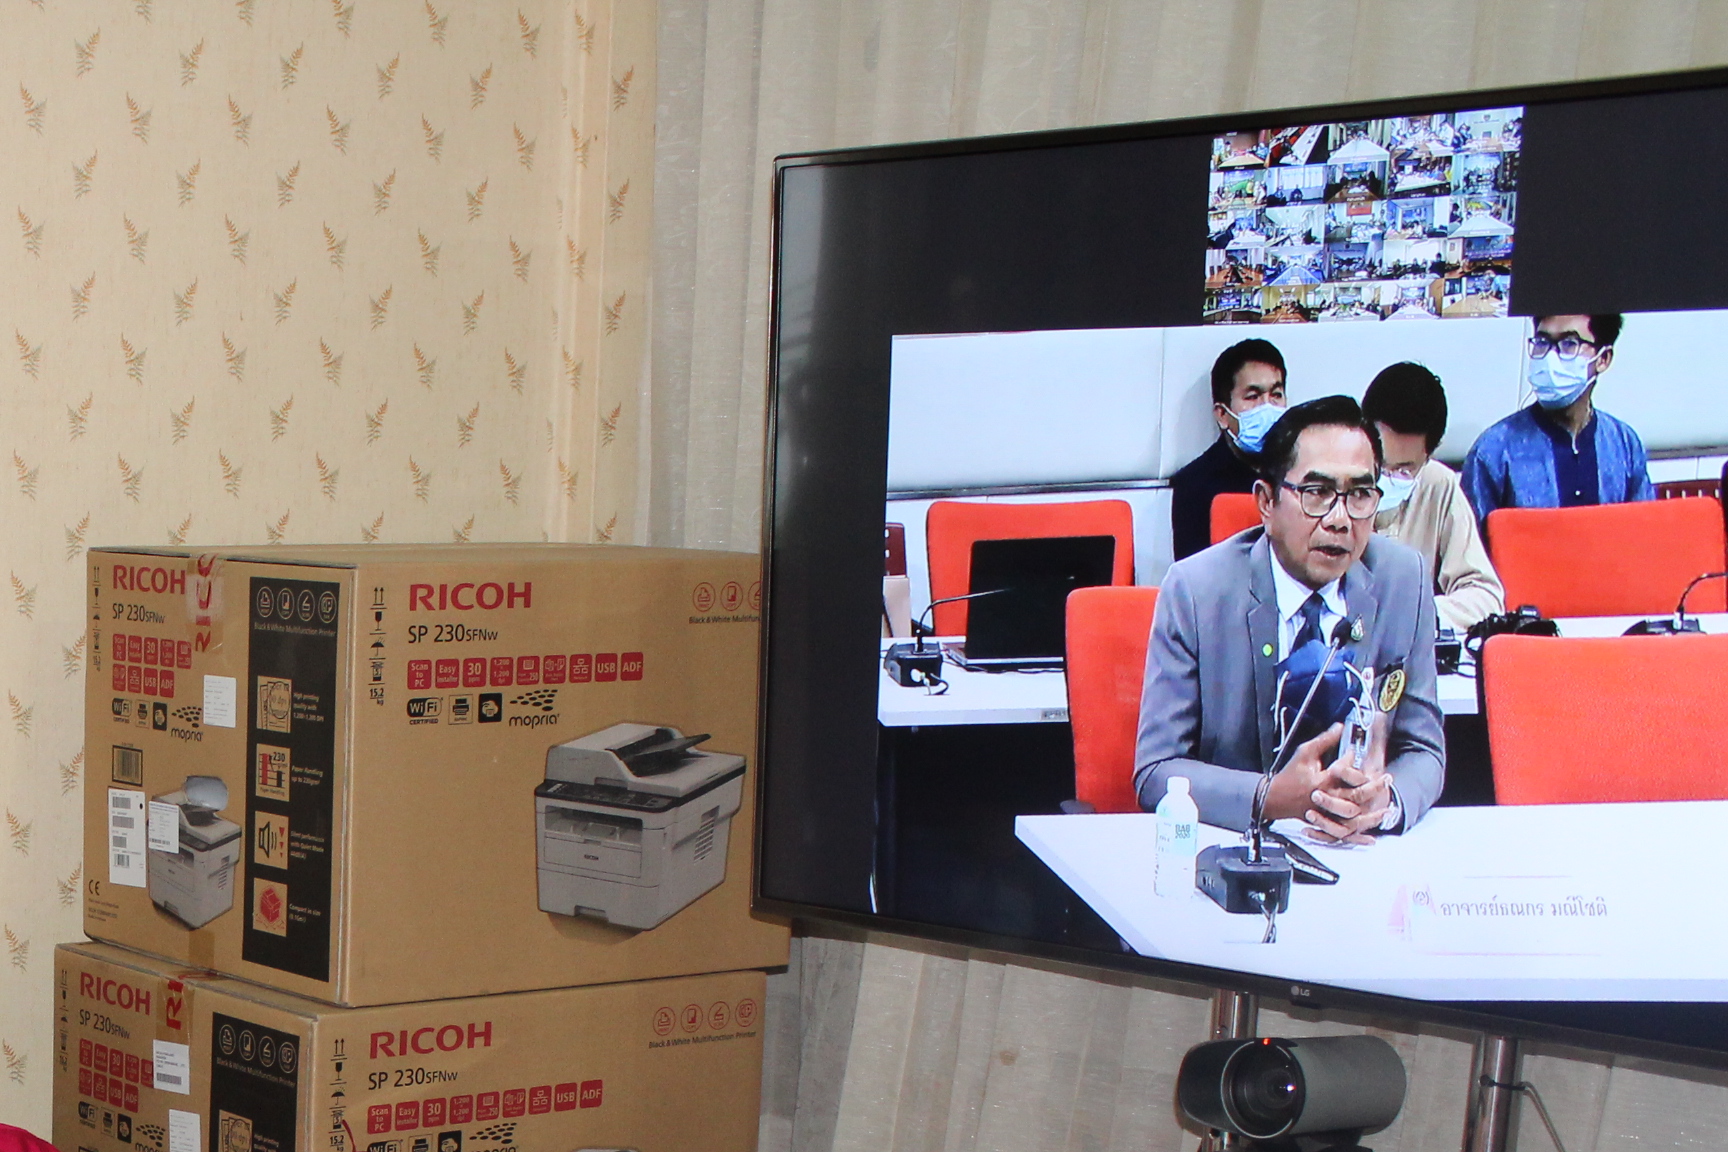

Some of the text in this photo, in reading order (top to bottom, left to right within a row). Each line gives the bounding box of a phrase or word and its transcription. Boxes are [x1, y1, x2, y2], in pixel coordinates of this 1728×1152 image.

[113, 564, 186, 595] RICOH
[409, 582, 532, 611] RICOH
[112, 603, 124, 620] SP
[408, 624, 498, 644] SP 230SFNw
[146, 644, 156, 654] 30
[411, 662, 428, 671] Scan
[439, 665, 456, 674] Easy
[468, 663, 481, 675] 30
[597, 662, 616, 673] USB
[622, 661, 643, 672] ADF
[145, 677, 157, 687] USB
[161, 679, 174, 689] ADF
[509, 714, 559, 729] mopria
[80, 972, 151, 1016] RICOH
[1300, 989, 1310, 997] LG
[79, 1009, 91, 1026] SP
[370, 1021, 492, 1059] RICOH
[692, 1033, 734, 1044] Multifunction
[736, 1031, 756, 1040] Printer
[112, 1053, 121, 1066] 30
[368, 1067, 458, 1091] SP 230SFNw
[110, 1088, 122, 1099] USB
[125, 1093, 138, 1104] ADF
[557, 1091, 575, 1103] USB
[582, 1089, 601, 1101] ADF
[371, 1108, 388, 1116] Scan
[399, 1107, 416, 1117] Easy
[427, 1103, 441, 1116] 30
[488, 1107, 498, 1116] 250
[374, 1122, 384, 1131] PC
